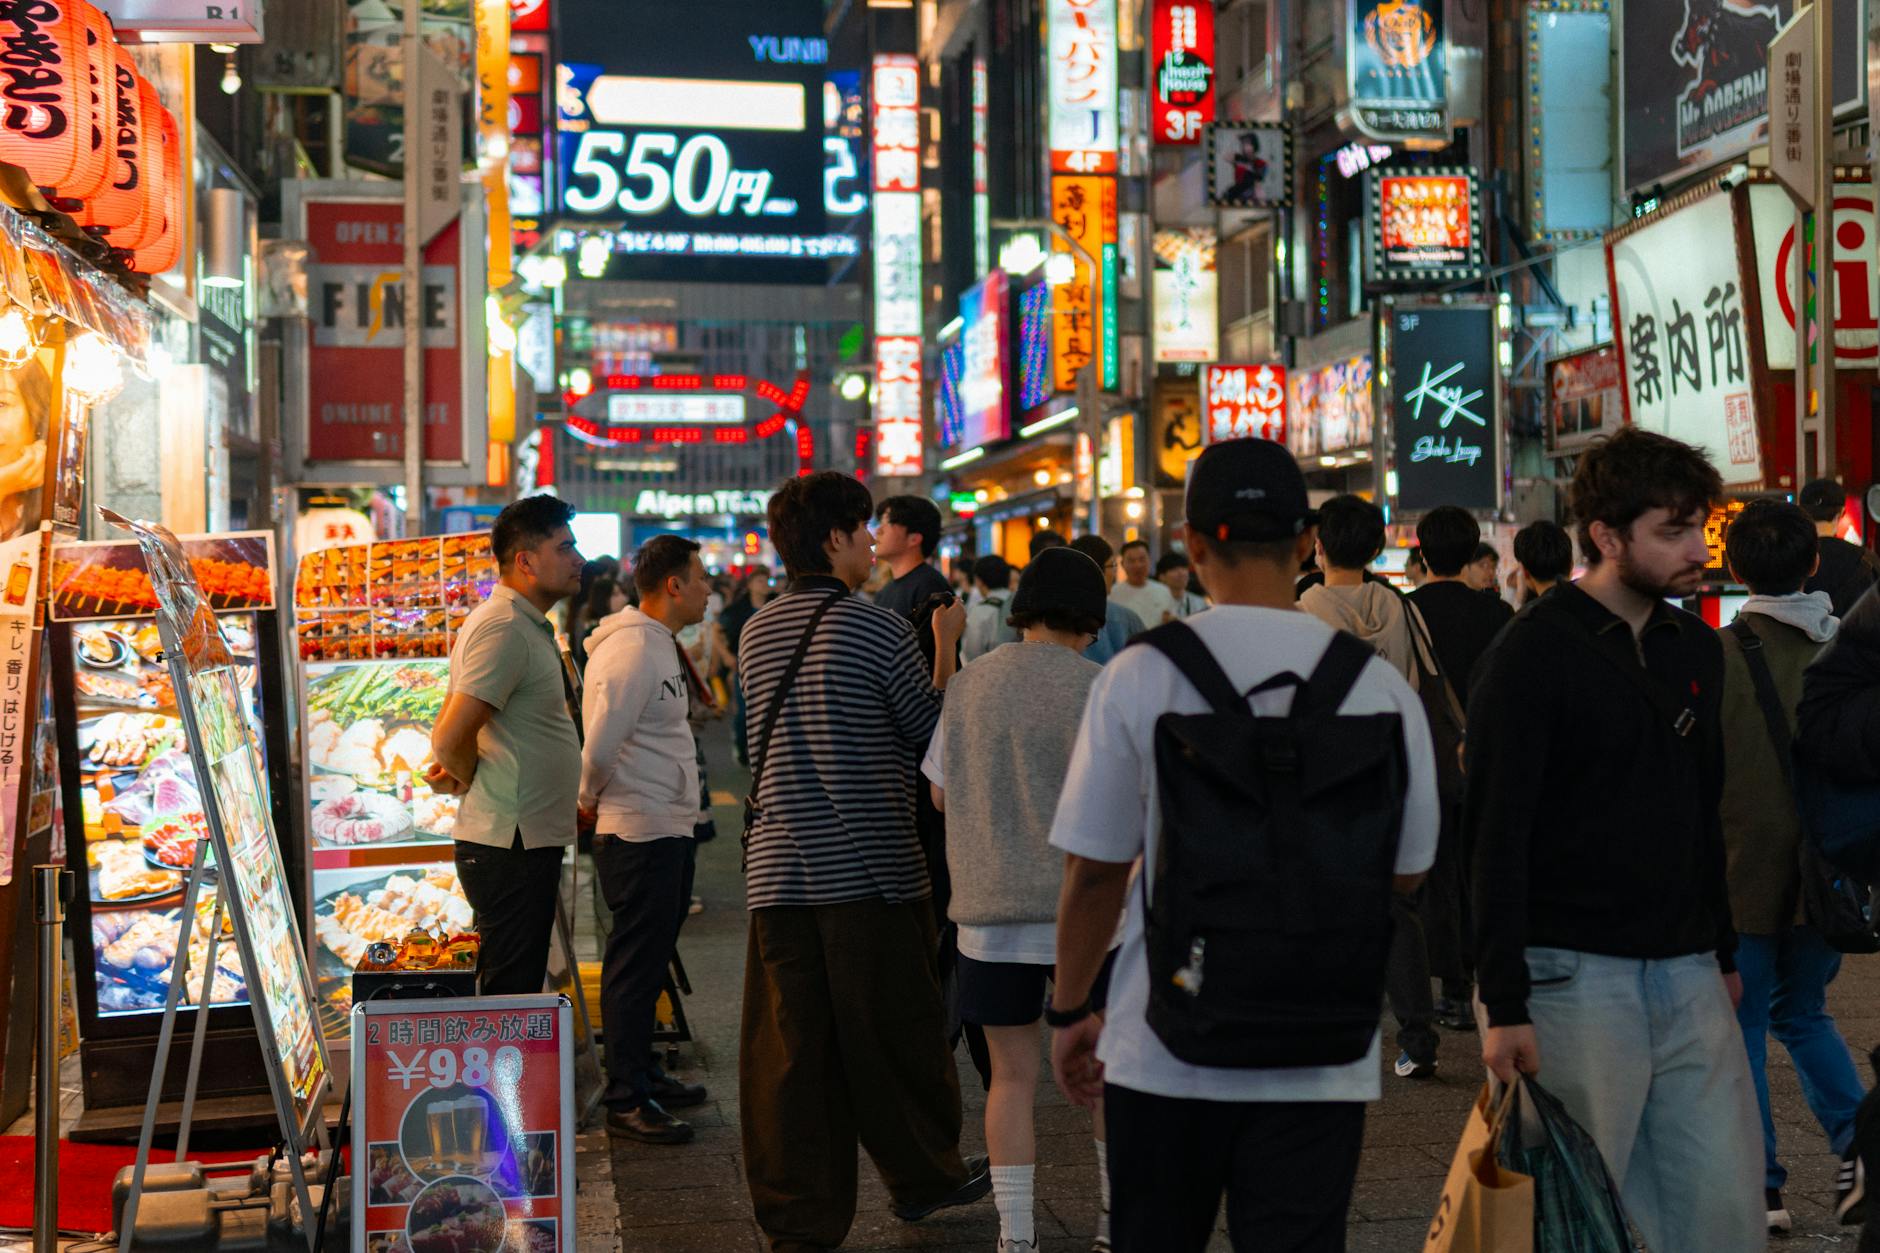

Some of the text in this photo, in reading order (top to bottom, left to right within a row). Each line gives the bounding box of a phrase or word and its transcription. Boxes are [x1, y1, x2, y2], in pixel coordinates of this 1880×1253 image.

[1166, 110, 1203, 140] 3F
[1785, 52, 1802, 163] 劇場通り一番街
[565, 132, 772, 215] 550円
[1065, 152, 1102, 172] 4F
[1628, 281, 1745, 407] 案内所
[368, 1013, 553, 1045] 2時間飲み放題
[386, 1045, 524, 1090] ¥980
